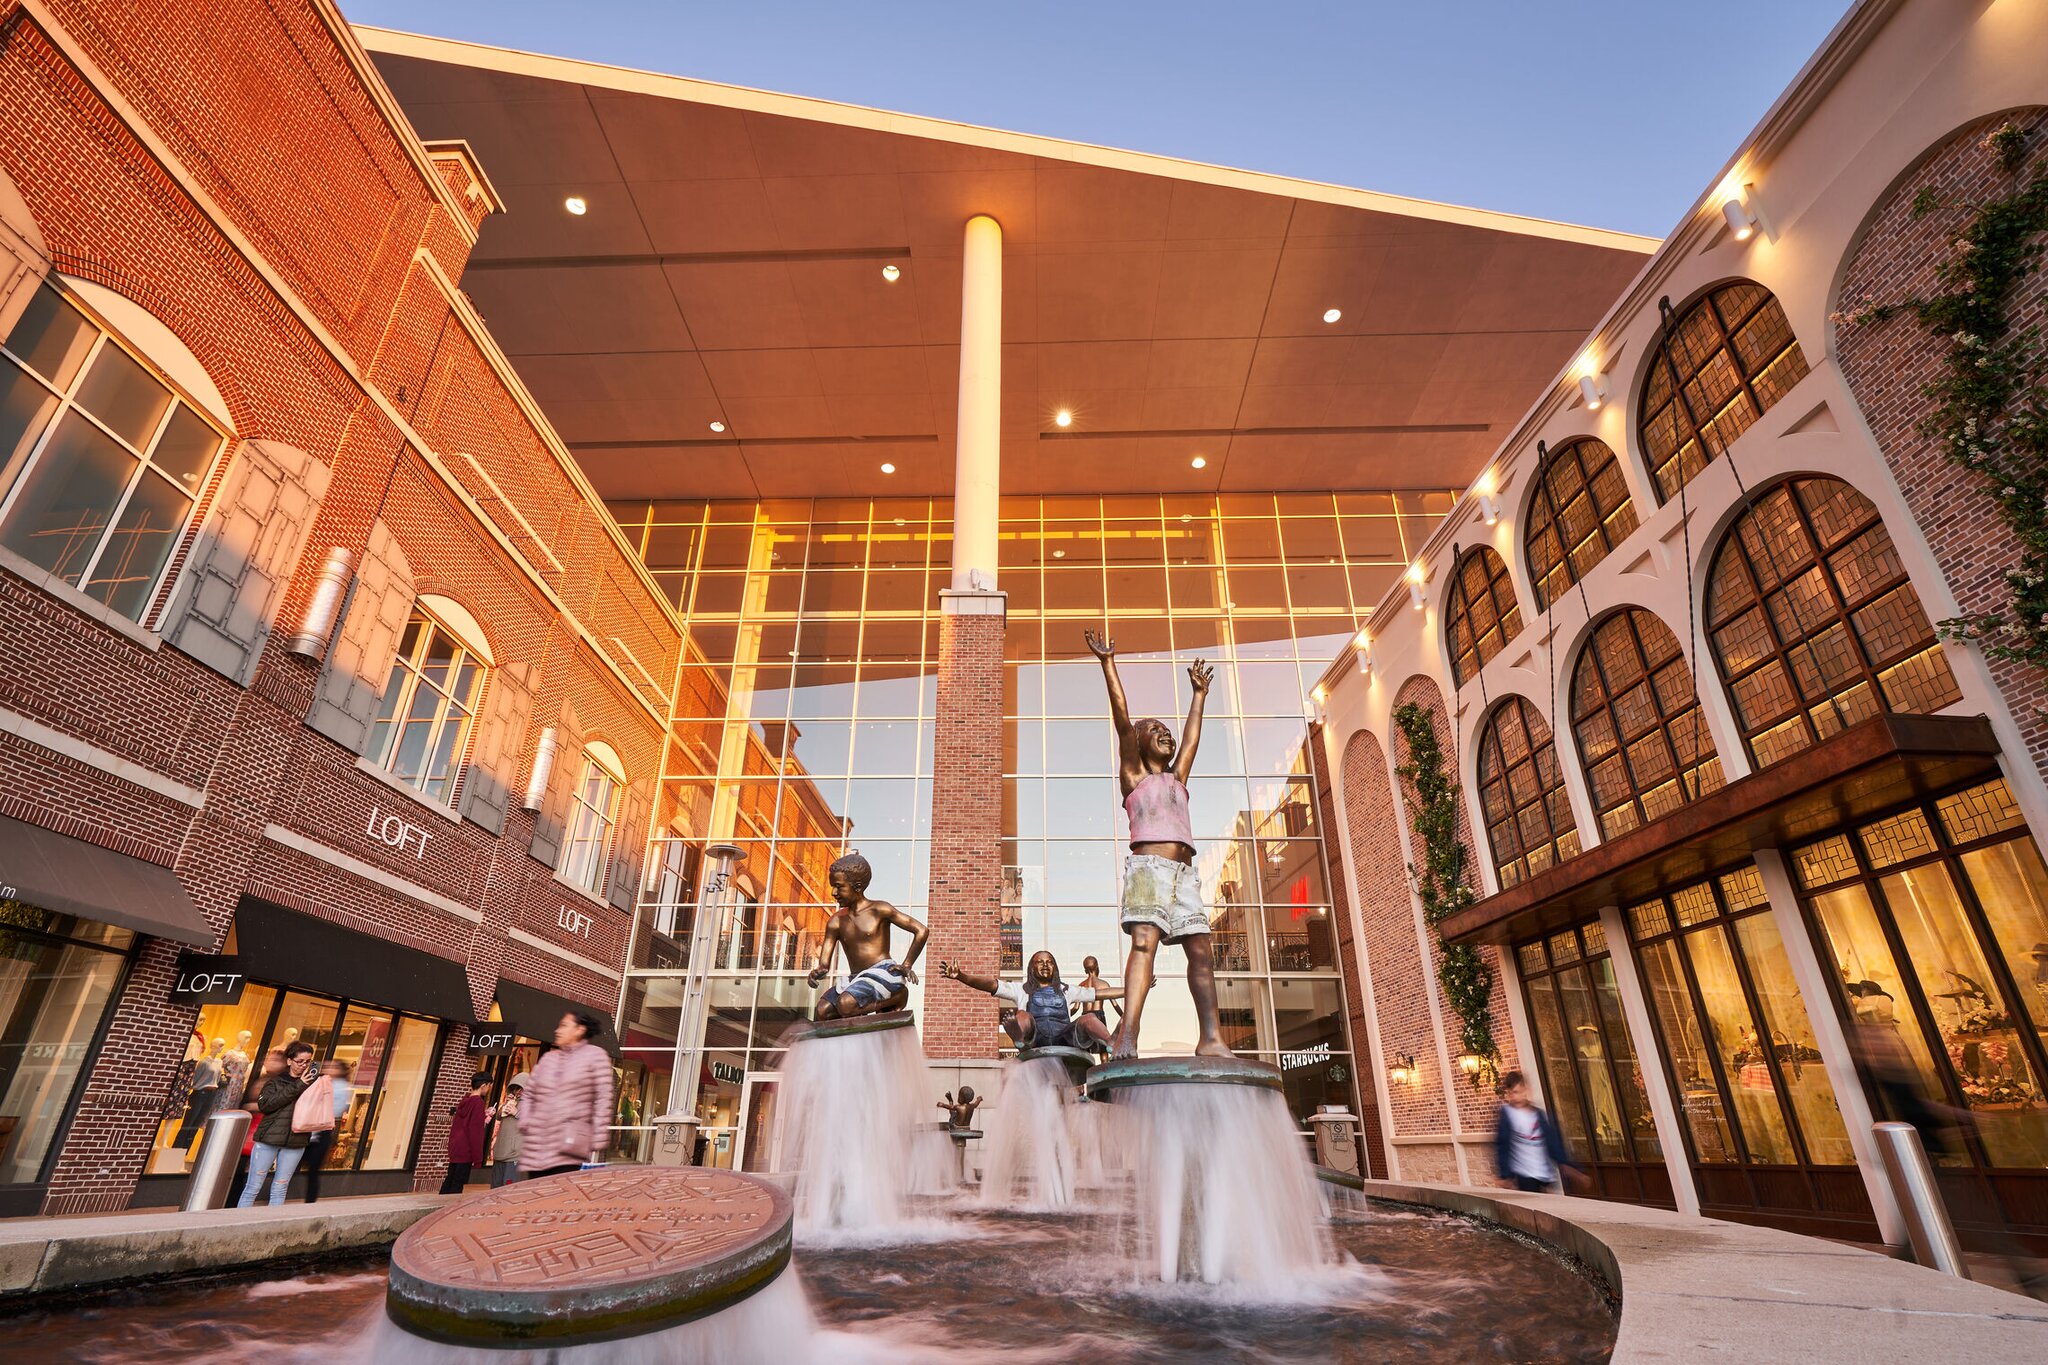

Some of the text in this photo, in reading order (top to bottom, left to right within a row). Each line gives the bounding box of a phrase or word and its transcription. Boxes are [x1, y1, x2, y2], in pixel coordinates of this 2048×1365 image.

[366, 806, 433, 859] LOFT
[558, 904, 594, 939] LOFT
[176, 973, 242, 993] LOFT
[470, 1034, 512, 1048] LOFT
[1282, 1042, 1331, 1071] STARBUCKS
[714, 1061, 745, 1085] TALBOT
